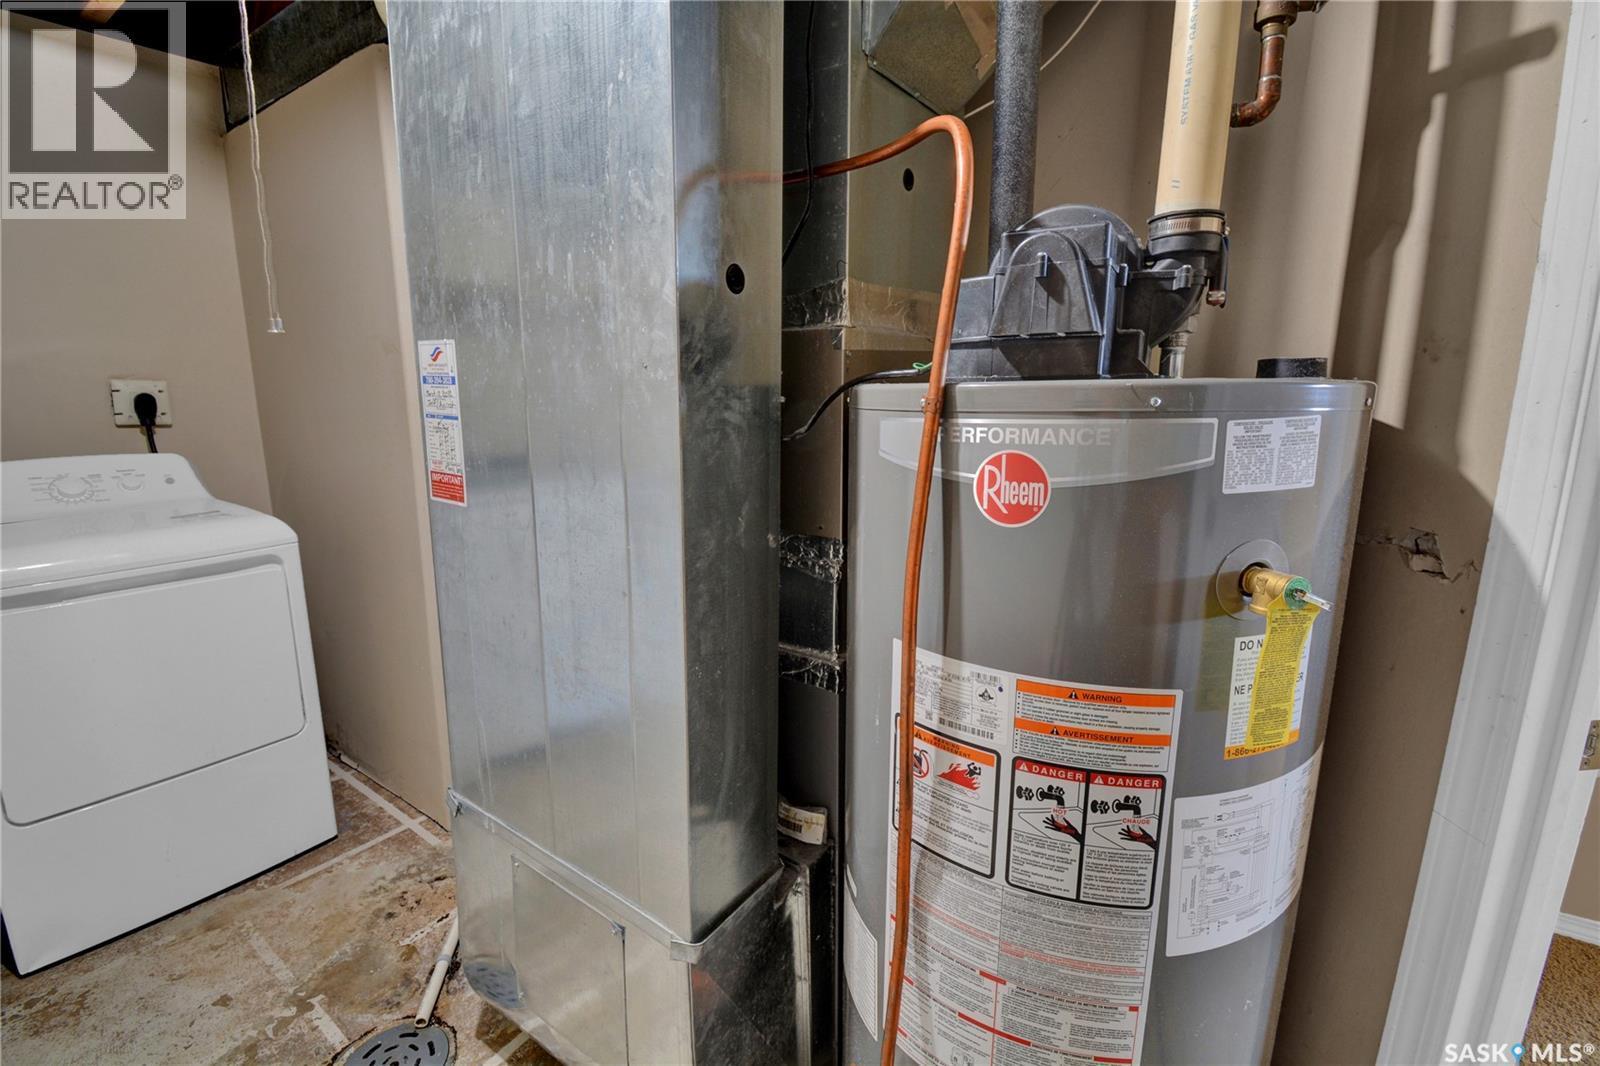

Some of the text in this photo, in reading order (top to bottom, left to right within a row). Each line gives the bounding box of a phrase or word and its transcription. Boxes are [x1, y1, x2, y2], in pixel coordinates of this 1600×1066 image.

[1082, 692, 1123, 704] WARNING
[1062, 728, 1134, 744] AVERTISSEMENT
[1031, 764, 1083, 782] DANGER
[1107, 776, 1160, 788] DANGER
[1052, 807, 1067, 816] HOT
[1122, 817, 1150, 825] CHAUDE
